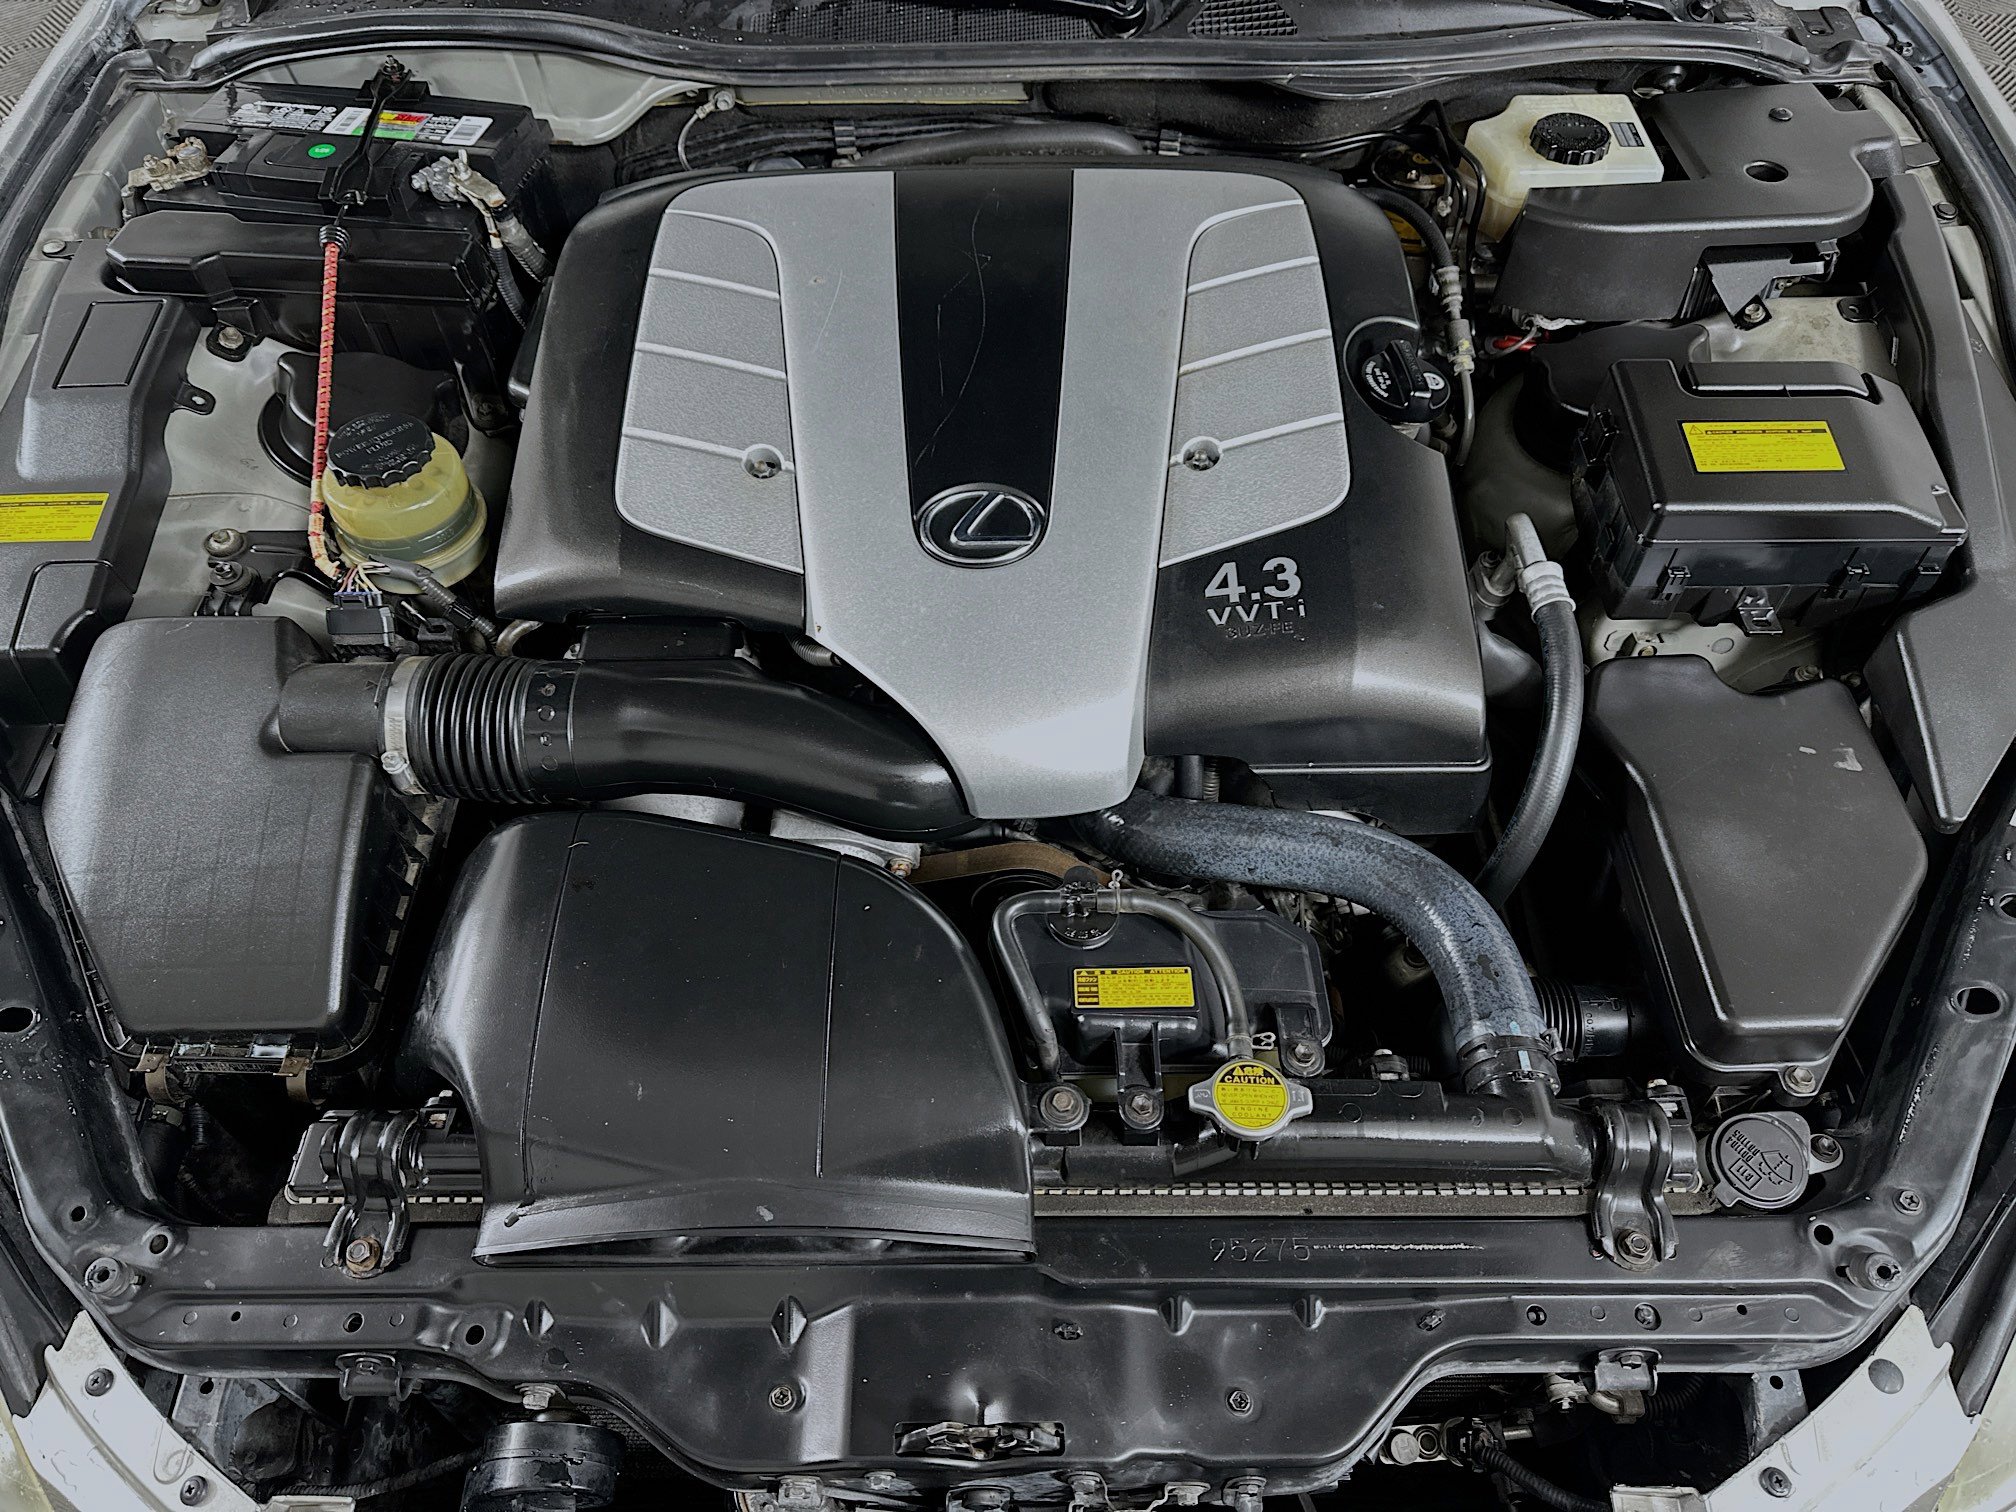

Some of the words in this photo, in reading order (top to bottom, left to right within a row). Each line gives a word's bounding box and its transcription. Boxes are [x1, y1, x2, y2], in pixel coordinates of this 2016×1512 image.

[1204, 556, 1302, 603] 4.3
[1206, 598, 1306, 627] VVT-i
[1224, 1075, 1275, 1085] CAUTION
[1209, 1237, 1311, 1262] 95275
